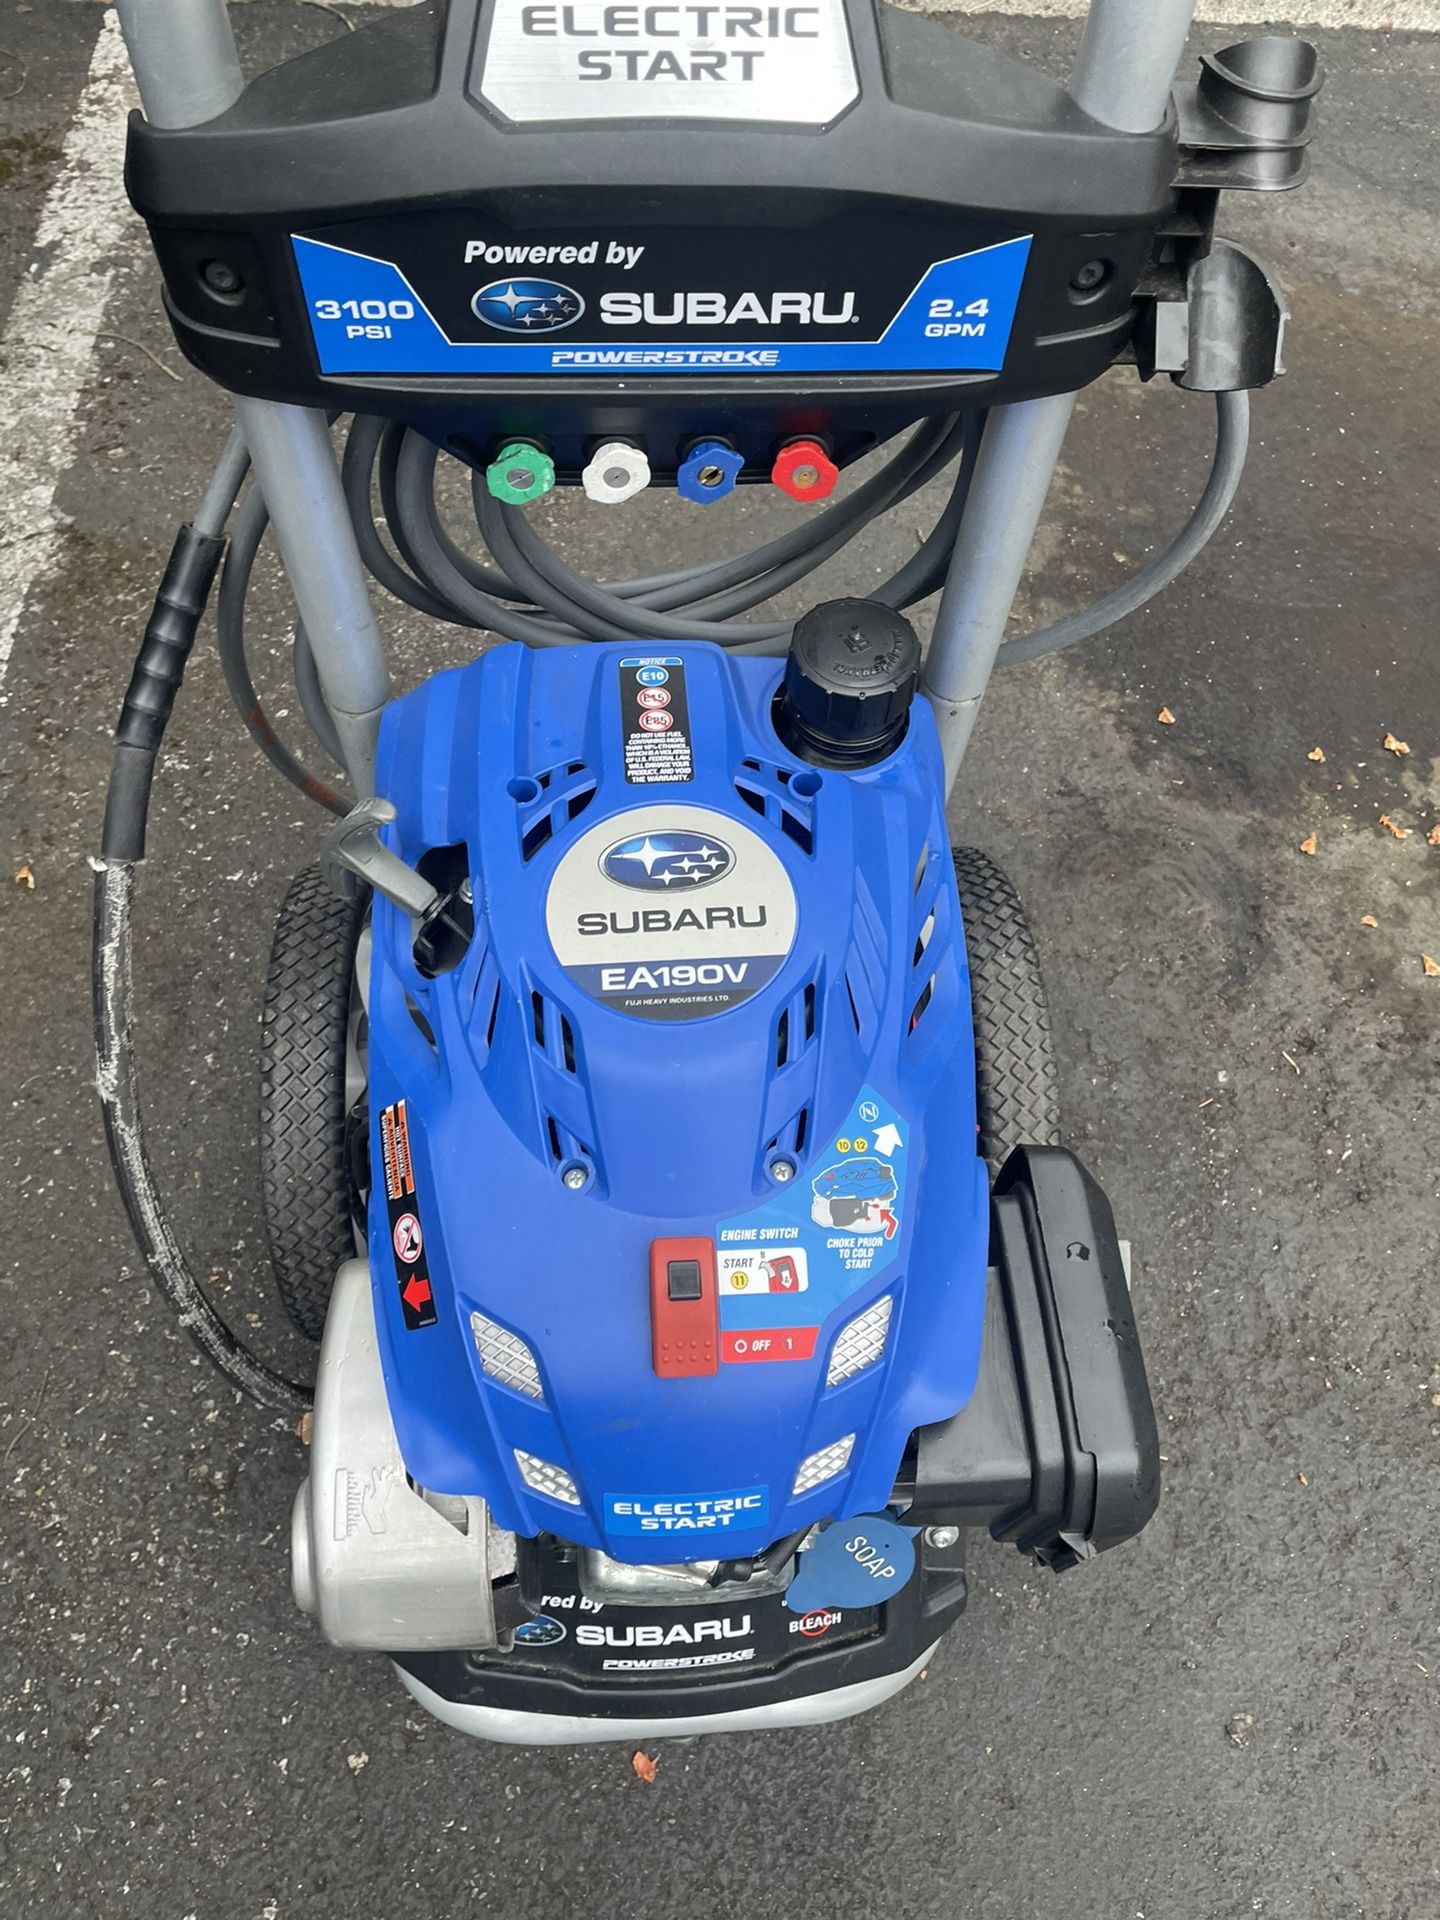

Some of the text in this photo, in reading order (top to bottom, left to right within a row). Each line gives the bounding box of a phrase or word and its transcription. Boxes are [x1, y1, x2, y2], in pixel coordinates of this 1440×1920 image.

[521, 5, 819, 38] ELECTRIC
[578, 50, 765, 81] START
[463, 240, 645, 270] Powered by
[314, 299, 415, 320] 3100
[599, 291, 857, 325] SUBARU
[928, 298, 989, 318] 2.4
[346, 325, 392, 339] PSI
[924, 323, 986, 337] GPM
[551, 350, 779, 367] POWERSTROKE
[641, 671, 664, 681] E10
[577, 905, 767, 936] SUBARU
[601, 962, 748, 991] EA190V
[669, 995, 713, 1004] INDUSTRIES
[839, 1141, 849, 1150] 10
[856, 1141, 866, 1150] 12
[720, 1227, 799, 1241] ENGINE SWITCH
[827, 1237, 883, 1248] CHOKE PRIOR
[839, 1248, 874, 1258] TO COLD
[723, 1257, 754, 1269] START
[845, 1259, 873, 1269] START
[734, 1275, 745, 1286] 11
[752, 1340, 771, 1352] OFF
[613, 1494, 762, 1516] ELECTRIC
[640, 1512, 736, 1531] START
[845, 1536, 896, 1578] SOAP
[579, 1595, 604, 1614] by
[576, 1615, 752, 1647] SUBARU
[789, 1612, 842, 1633] BLEACH
[602, 1648, 756, 1671] POWERSTROKE
